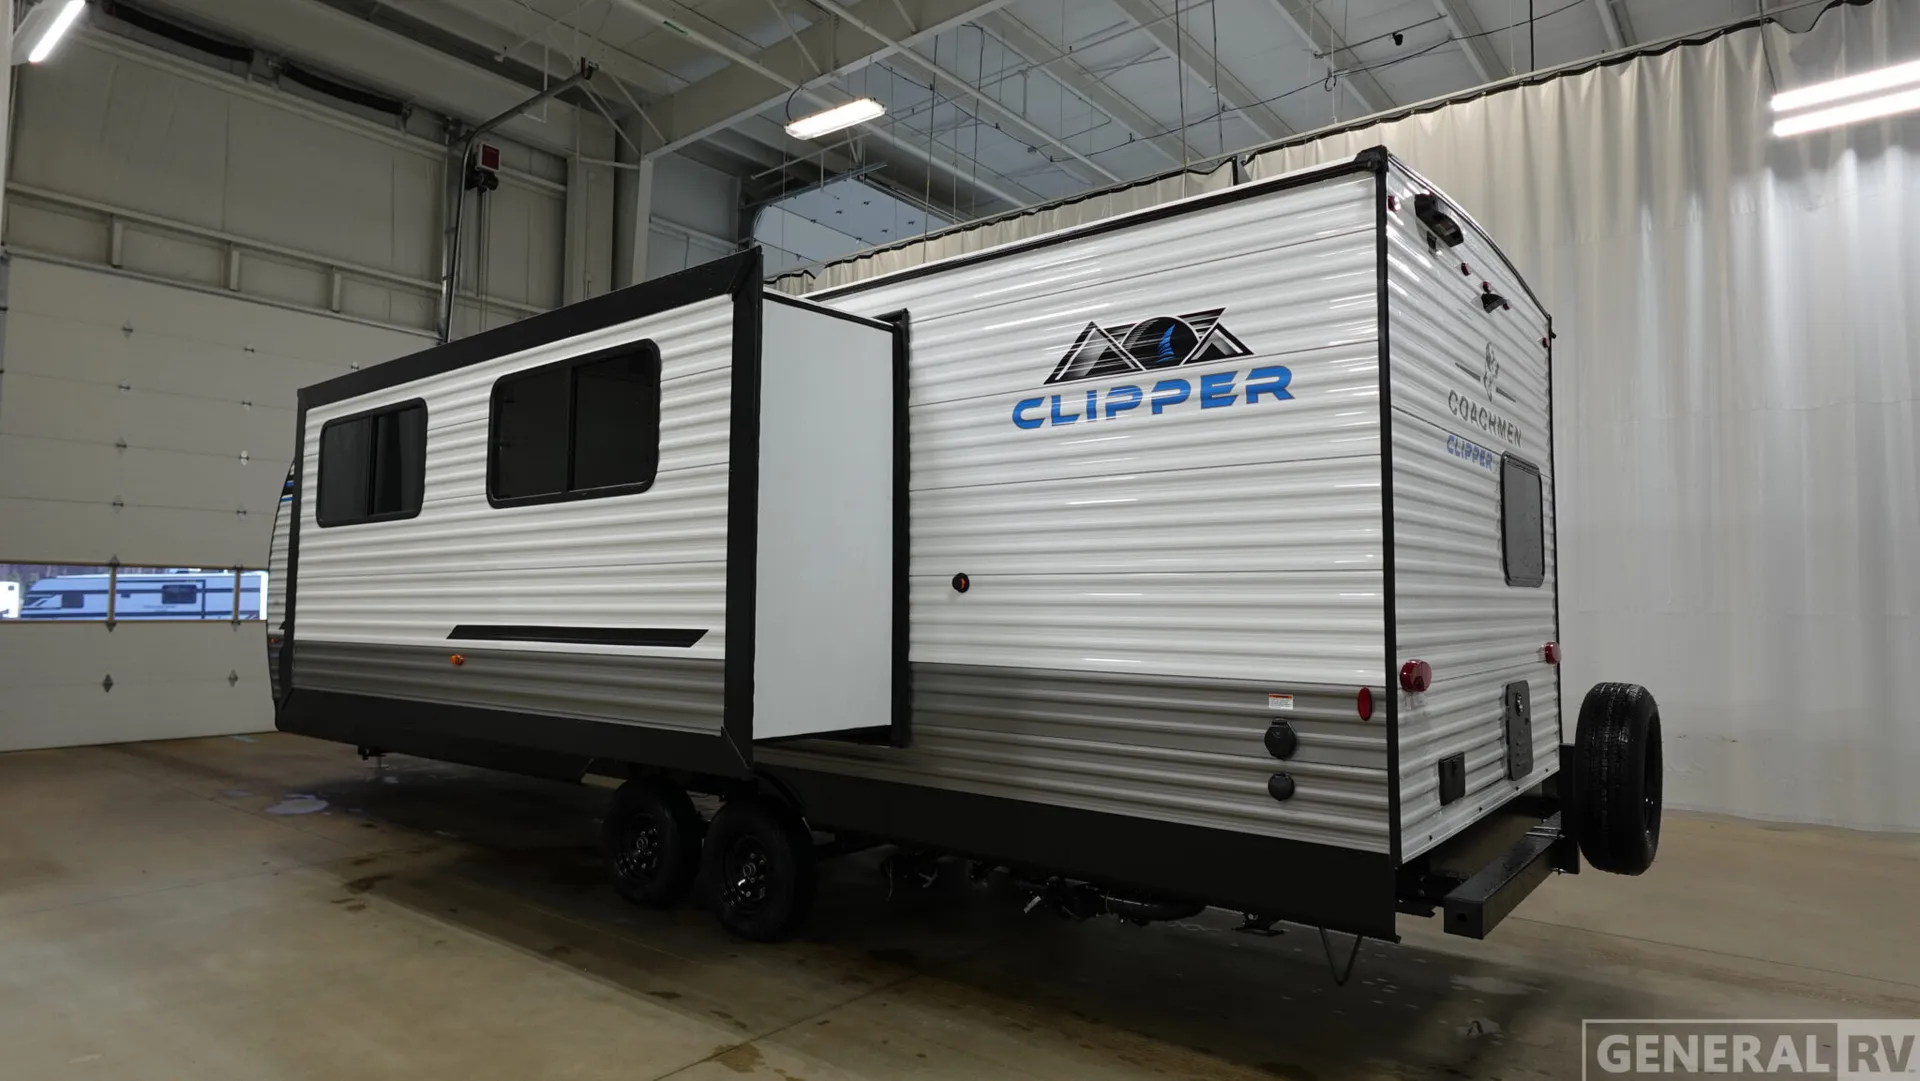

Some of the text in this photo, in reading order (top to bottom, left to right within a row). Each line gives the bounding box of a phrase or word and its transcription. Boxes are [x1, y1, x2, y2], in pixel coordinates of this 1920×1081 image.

[1012, 365, 1295, 429] CLIPPER
[1448, 389, 1522, 448] COACHMEN
[1446, 434, 1493, 471] CLIPPER
